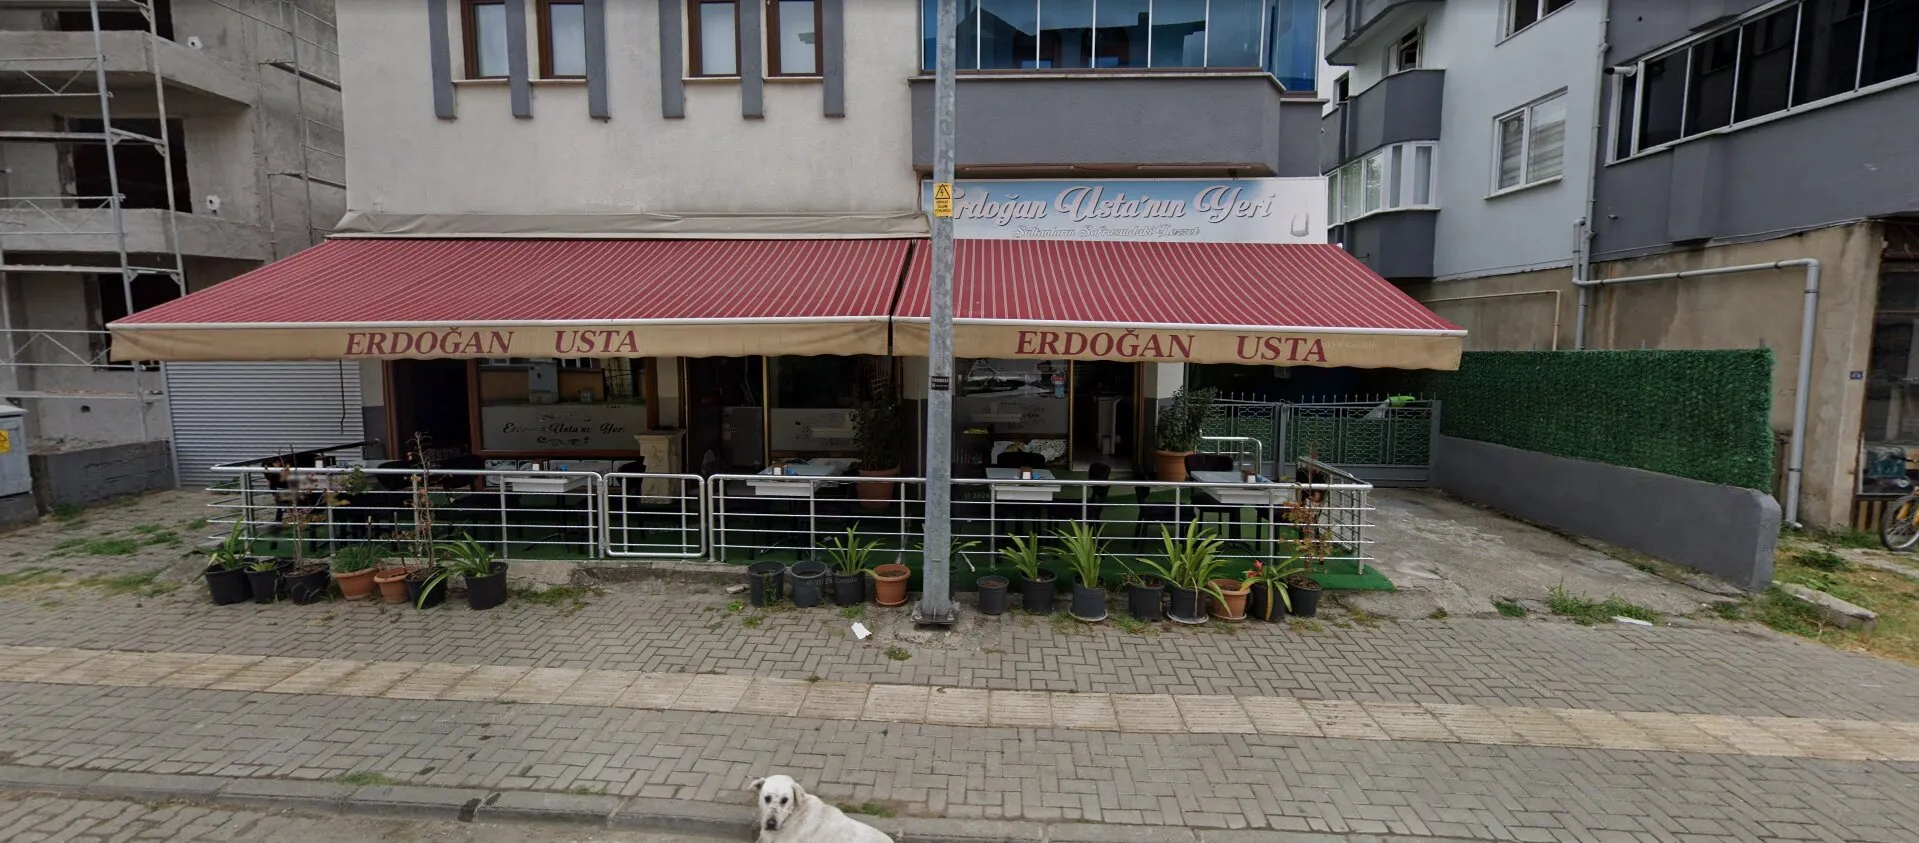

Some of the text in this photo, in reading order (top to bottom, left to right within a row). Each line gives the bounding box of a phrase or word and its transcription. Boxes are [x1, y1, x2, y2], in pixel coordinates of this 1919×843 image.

[1054, 185, 1186, 222] Usta'nın
[1193, 185, 1277, 223] Yeri
[343, 326, 639, 356] ERDOĞAN USTA
[1014, 328, 1328, 363] ERDOĞAN USTA
[599, 421, 625, 435] Yer
